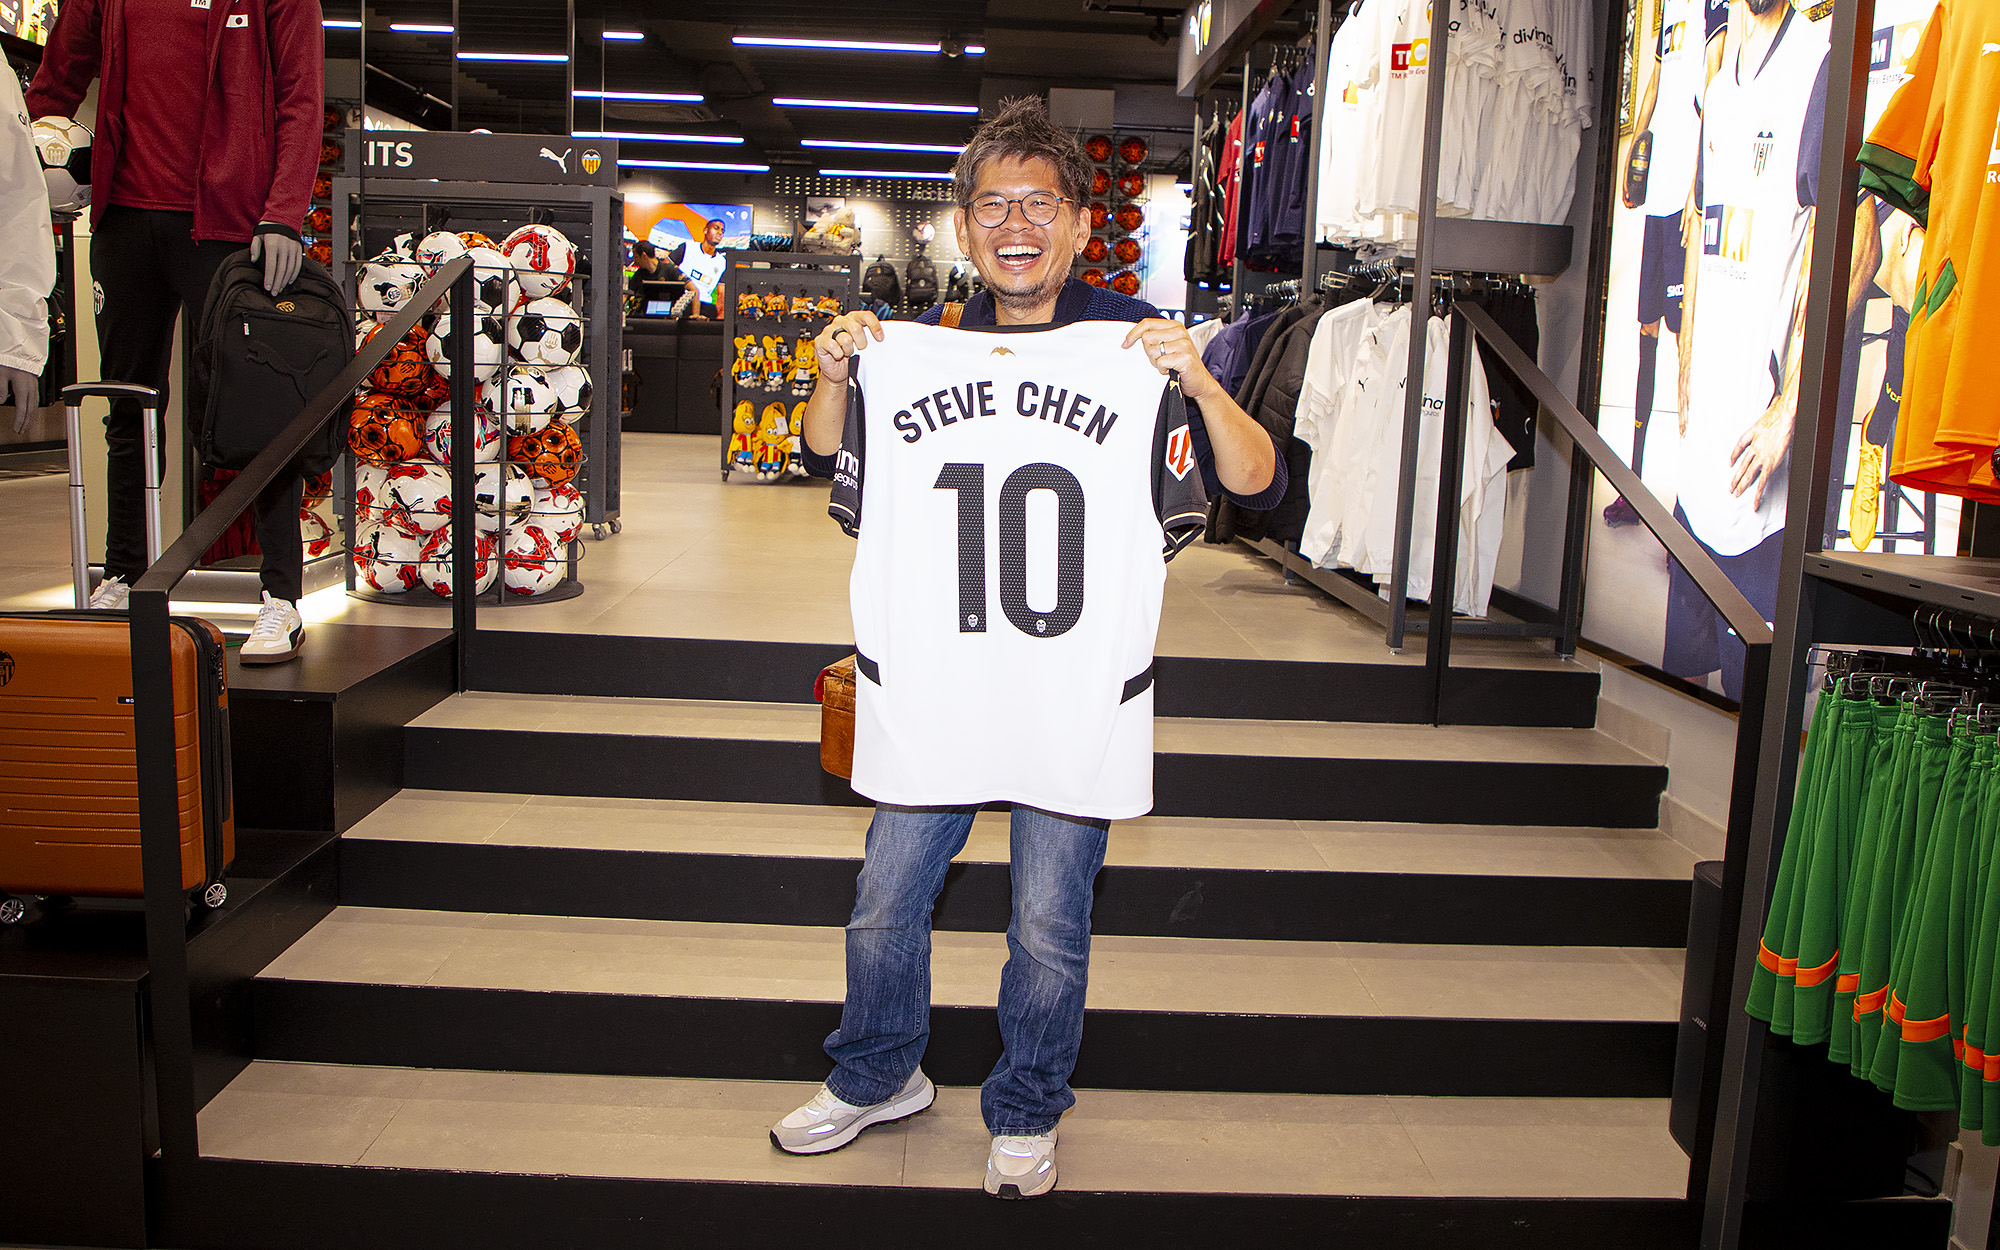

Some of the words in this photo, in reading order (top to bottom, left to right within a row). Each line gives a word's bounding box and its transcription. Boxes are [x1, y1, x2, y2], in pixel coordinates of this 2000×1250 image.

[1513, 26, 1554, 47] divina
[911, 189, 956, 202] ACCES
[893, 380, 996, 444] STEVE
[1016, 381, 1119, 446] CHEN
[1422, 393, 1444, 410] ina
[835, 442, 860, 479] ina
[933, 462, 1086, 638] 10
